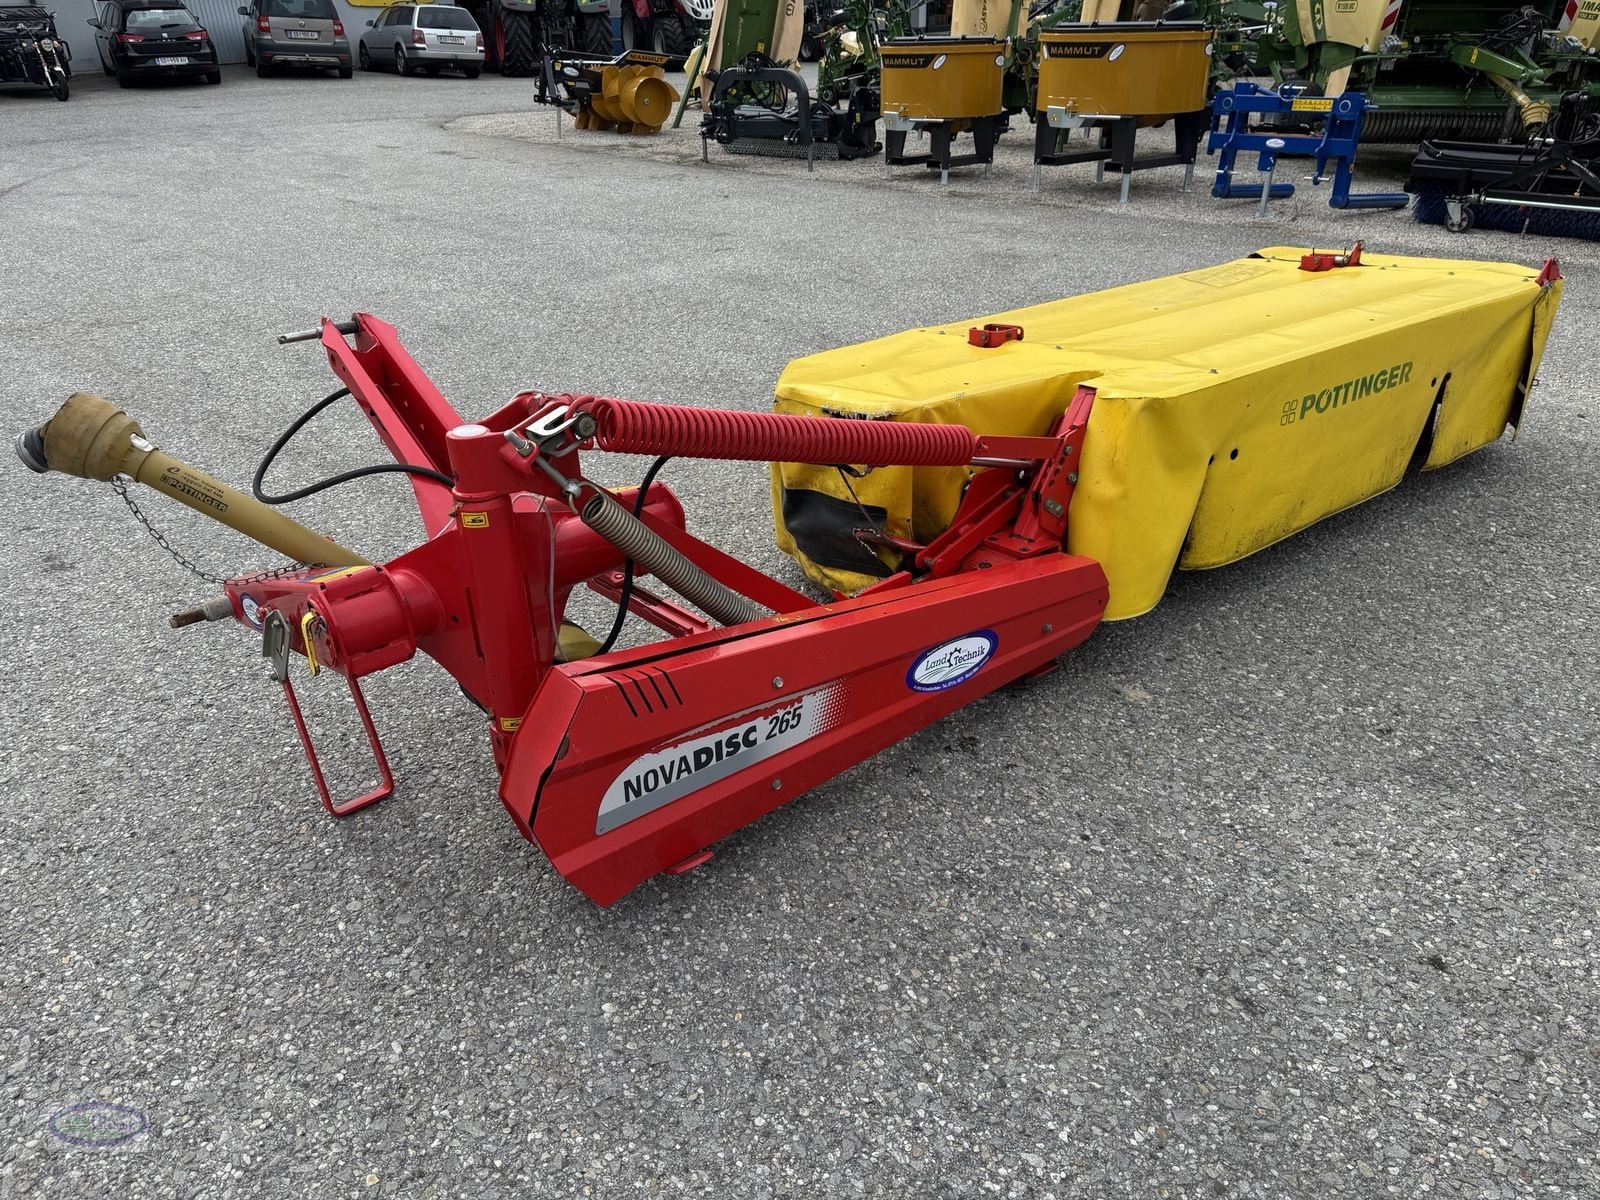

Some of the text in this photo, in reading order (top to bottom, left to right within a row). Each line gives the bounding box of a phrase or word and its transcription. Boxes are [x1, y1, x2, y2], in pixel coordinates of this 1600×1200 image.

[630, 53, 664, 62] MAMMUT
[1050, 46, 1101, 55] MAMMUT
[884, 57, 925, 66] MAMMUT
[1300, 361, 1413, 420] PÖTTINGER
[925, 653, 948, 671] Land
[953, 645, 986, 666] Technik
[623, 705, 803, 803] NOVADISC 265
